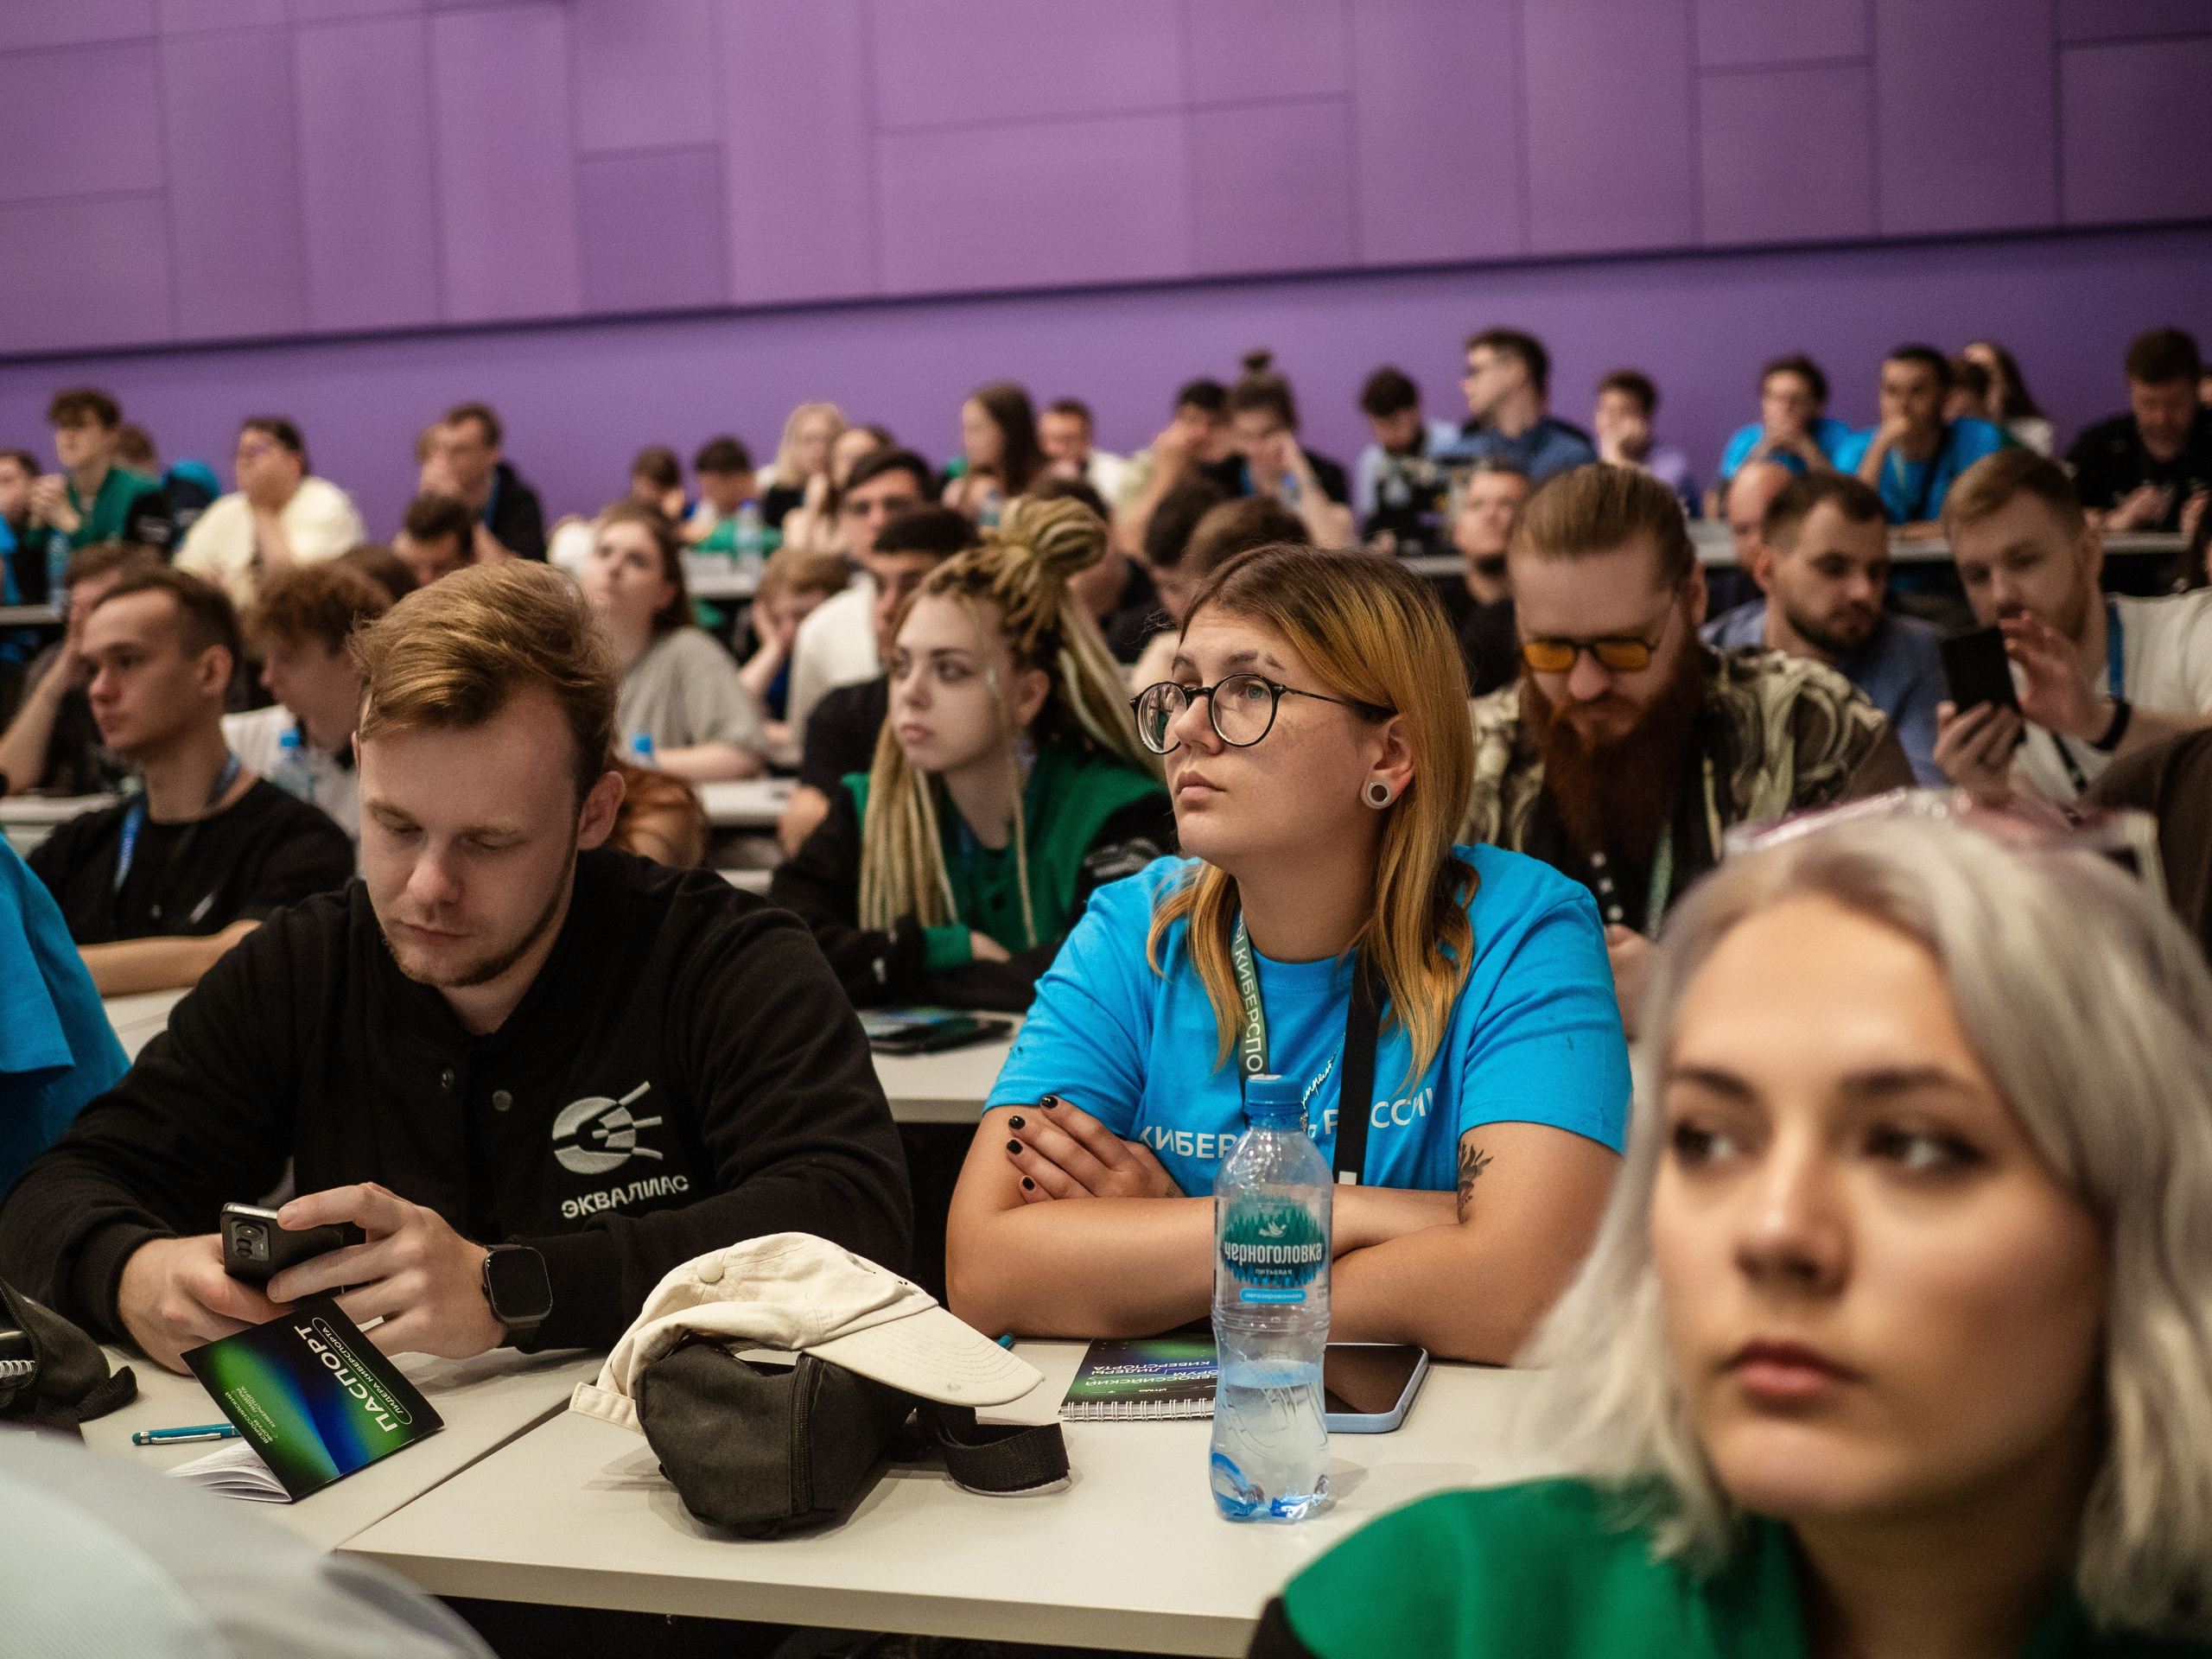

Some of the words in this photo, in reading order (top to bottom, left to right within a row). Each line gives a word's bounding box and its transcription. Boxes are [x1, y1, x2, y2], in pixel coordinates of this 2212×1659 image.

[1235, 949, 1263, 1073] КИБЕРСПО
[1138, 1126, 1237, 1159] КИБЕР
[1324, 1088, 1433, 1136] РССИ
[562, 1175, 690, 1219] ЭКВАЛИАС
[322, 1326, 373, 1382] КИБЕРСПОРТА
[1094, 1361, 1210, 1371] КИБЕРСПОРТА
[294, 1325, 398, 1433] ПАСПОРТ
[373, 1382, 404, 1414] ЛИДЕРА
[1085, 1375, 1218, 1386] СЕРОССИЙСКИЙ
[226, 1392, 270, 1444] ВСЕРОССИЙСКИЙ
[236, 1388, 258, 1413] ЛИДЕРЫ
[241, 1386, 276, 1427] КИБЕРСПОРТА
[253, 1420, 273, 1441] ФОРУМ
